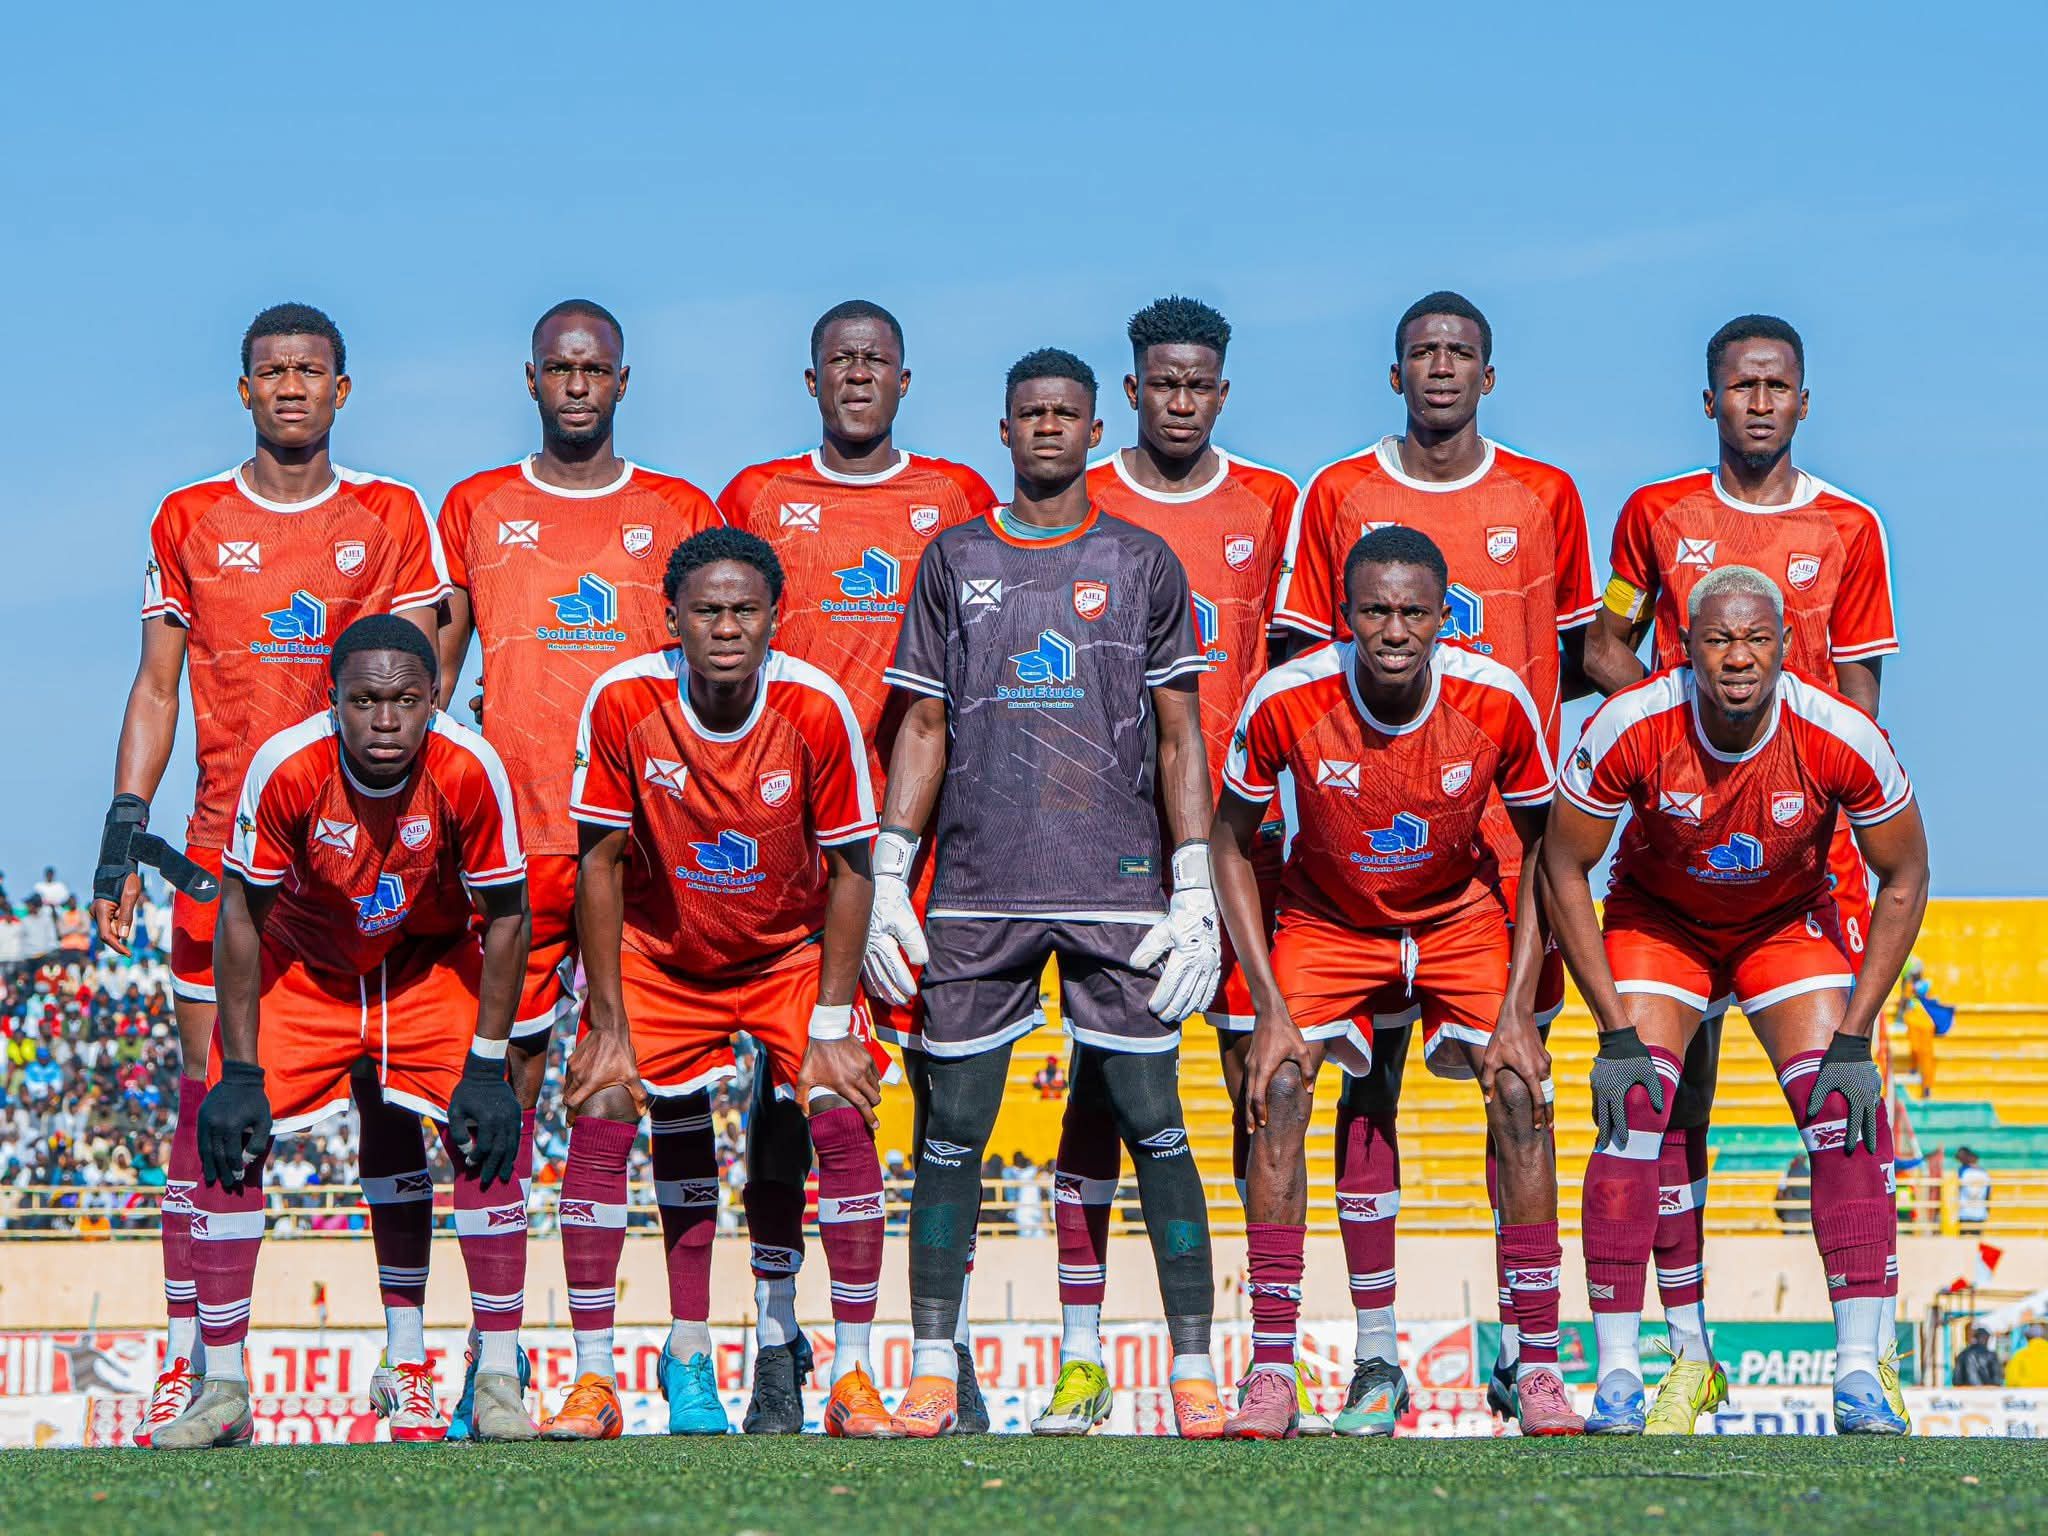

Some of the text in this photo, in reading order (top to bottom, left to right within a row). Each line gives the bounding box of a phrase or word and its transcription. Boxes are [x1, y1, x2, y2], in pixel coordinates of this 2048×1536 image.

[821, 599, 905, 614] SoluEtude
[536, 627, 626, 641] SoluEtude
[250, 641, 332, 655] SoluEtude
[997, 685, 1085, 699] SoluEtude
[1778, 800, 1800, 810] AJEL
[675, 866, 766, 886] SoluEtude
[1846, 916, 1864, 954] 8
[922, 1151, 962, 1168] umbro
[1151, 1144, 1190, 1160] umbro
